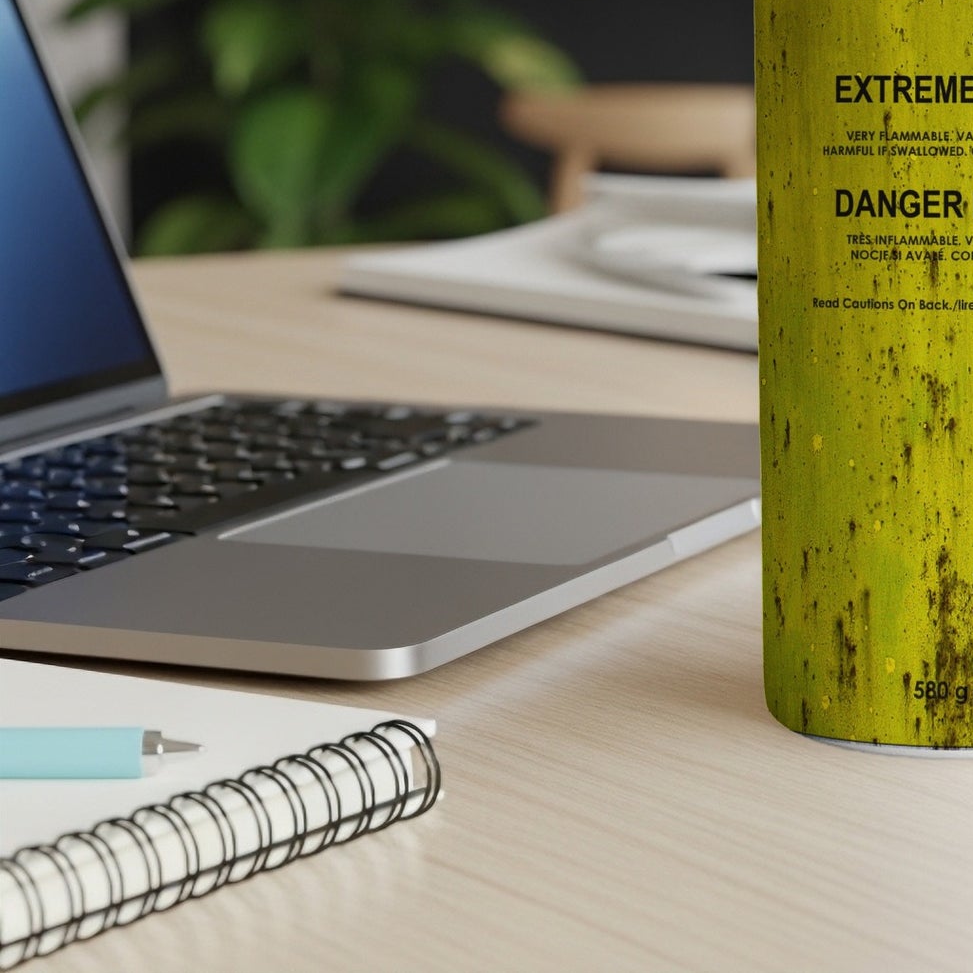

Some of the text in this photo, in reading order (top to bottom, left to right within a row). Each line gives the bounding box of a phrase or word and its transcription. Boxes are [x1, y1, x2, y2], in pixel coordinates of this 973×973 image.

[846, 131, 876, 141] VERY
[880, 131, 953, 142] FLAMMABLE.
[823, 146, 875, 156] HARMFUL
[878, 146, 888, 156] IF
[891, 146, 967, 157] SWALLOWED.
[835, 189, 964, 218] DANGER
[847, 232, 872, 245] TRÈS
[875, 235, 962, 246] INFLAMMABLE.
[813, 297, 839, 308] Read
[843, 298, 894, 310] Cautions
[898, 299, 915, 310] On
[914, 681, 948, 699] 580
[955, 685, 968, 704] g
